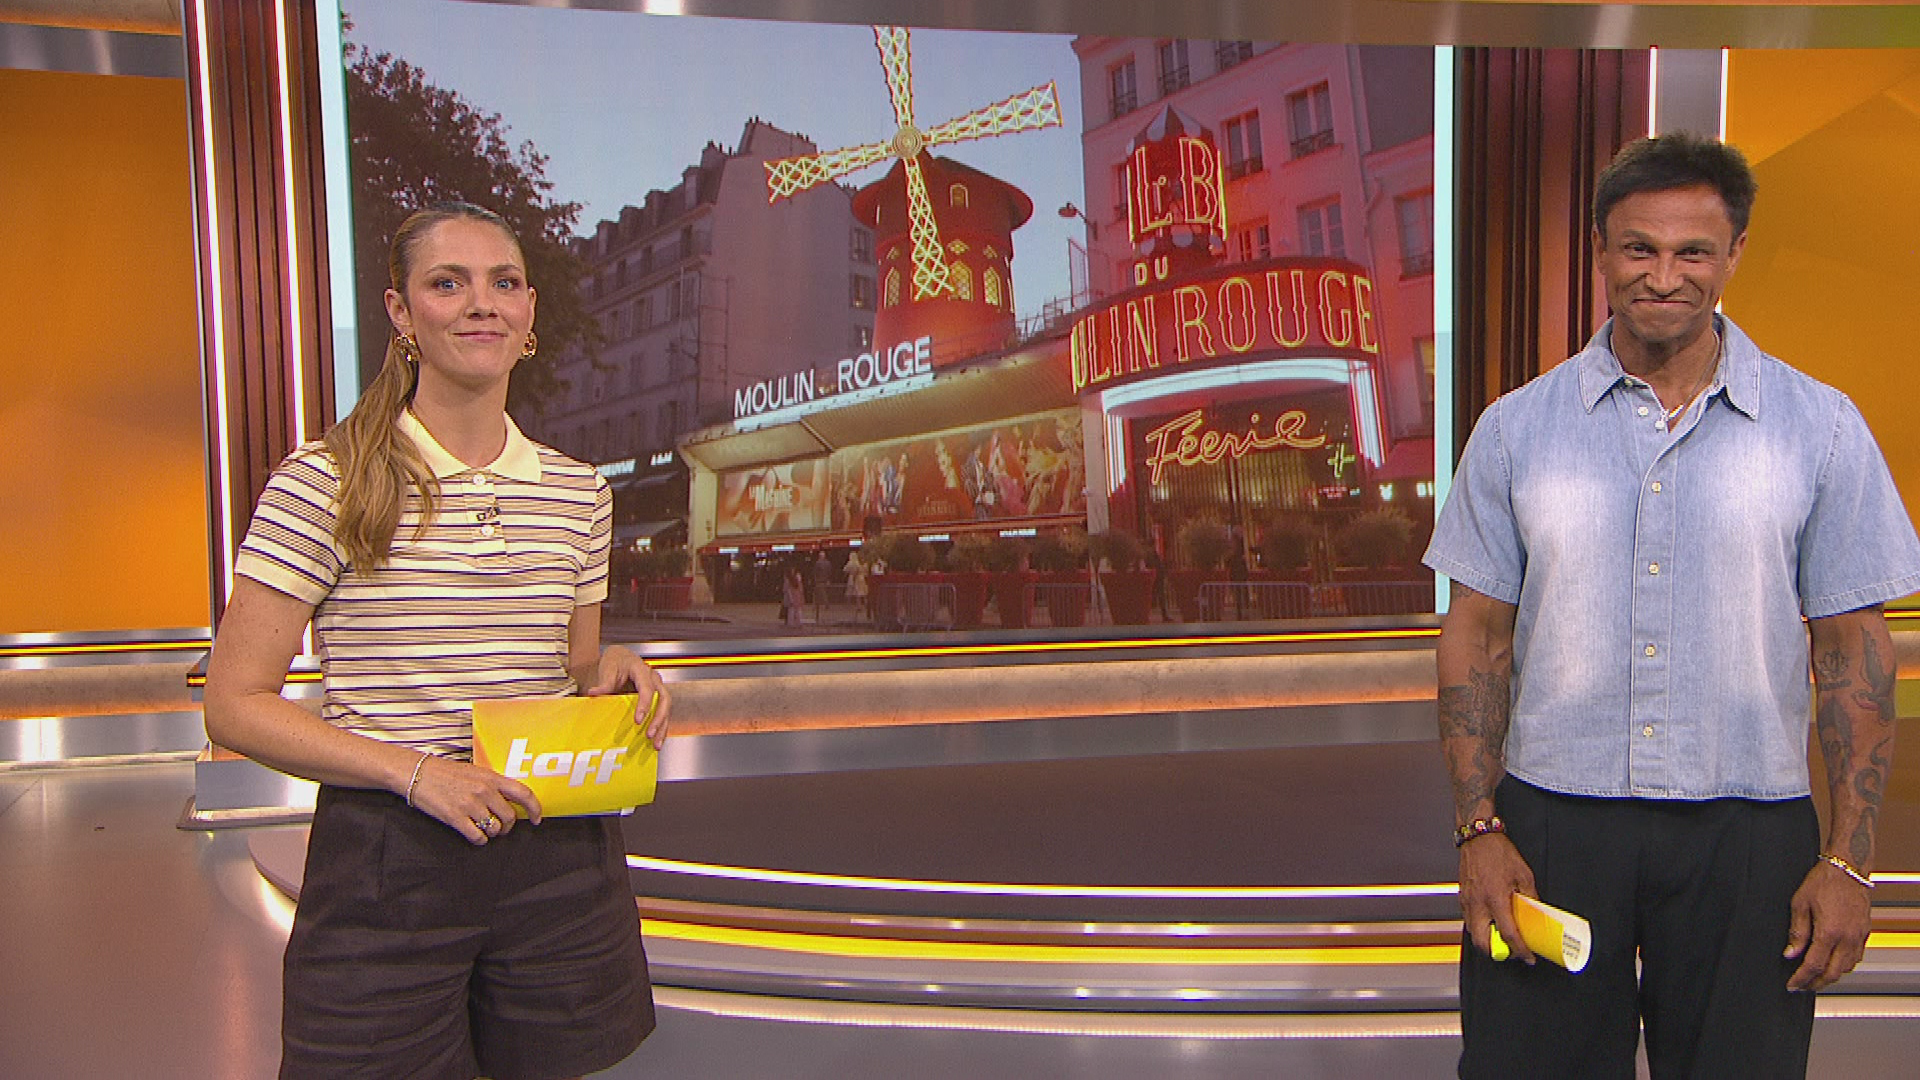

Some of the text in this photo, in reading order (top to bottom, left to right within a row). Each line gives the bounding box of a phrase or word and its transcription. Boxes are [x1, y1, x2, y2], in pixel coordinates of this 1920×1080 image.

[1134, 255, 1168, 286] DU
[1173, 270, 1378, 362] ROUGE
[734, 335, 931, 418] MOULIN ROUGE
[504, 737, 628, 787] taff
